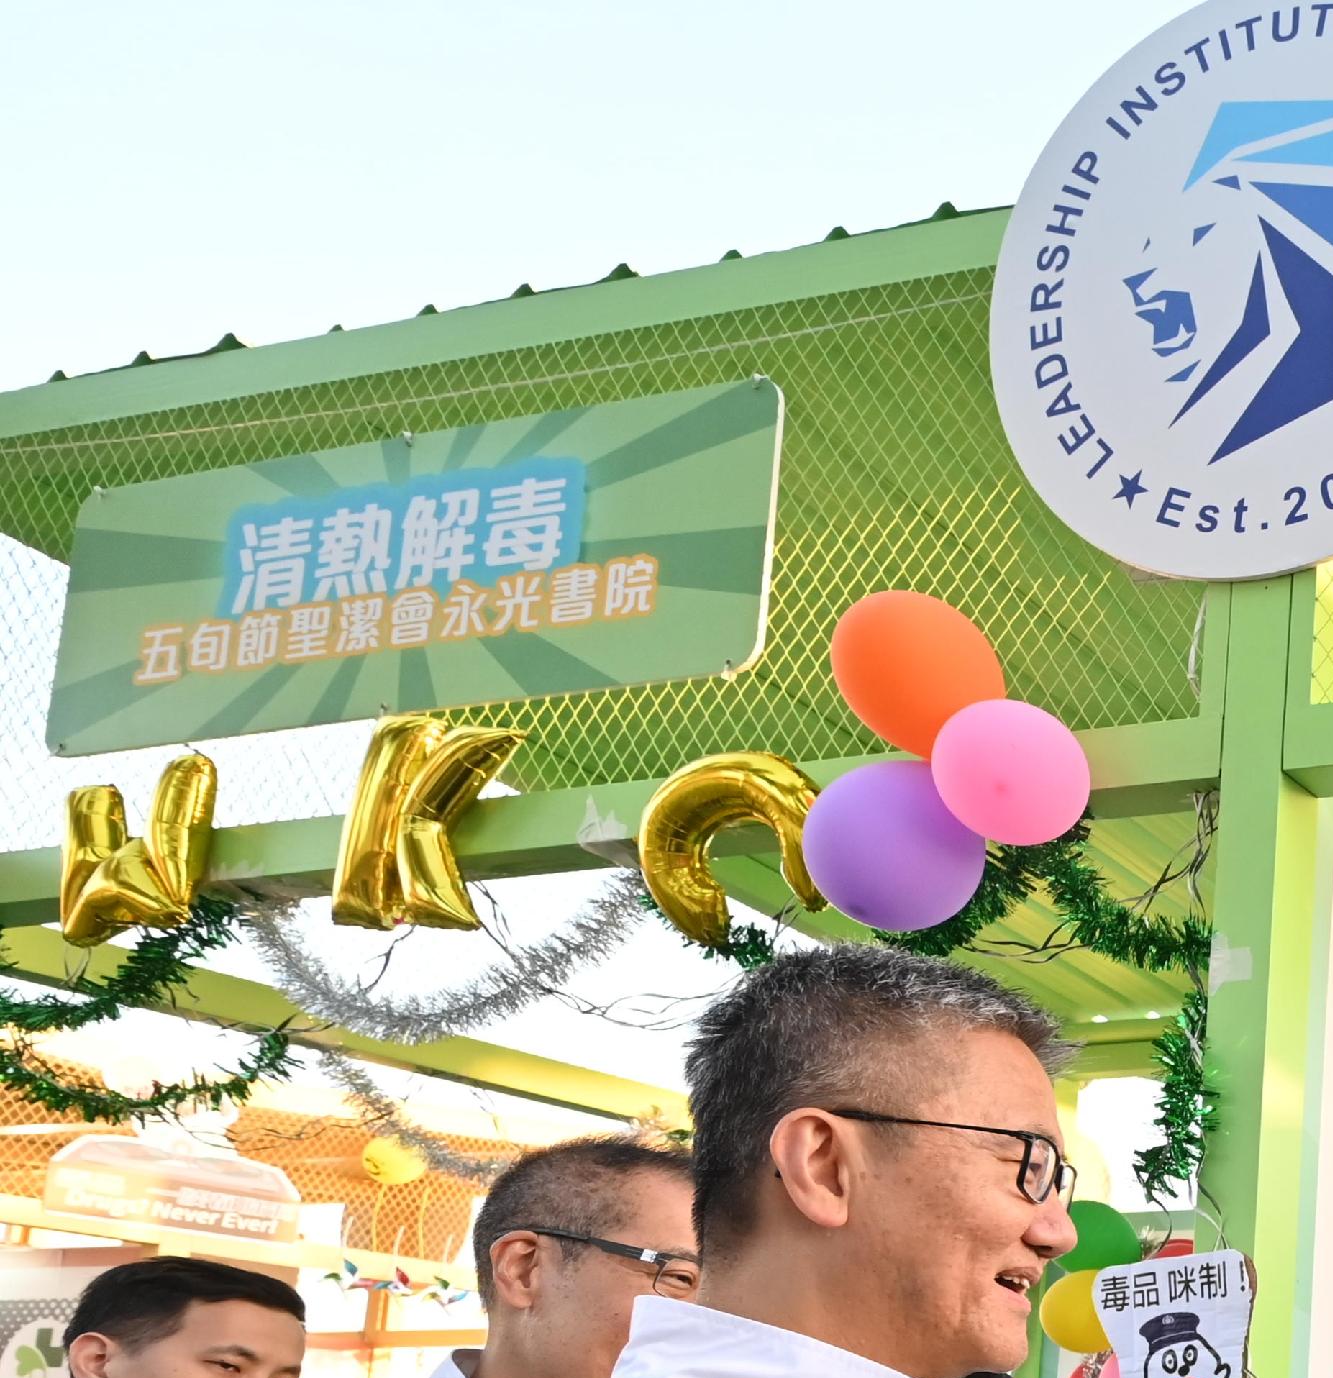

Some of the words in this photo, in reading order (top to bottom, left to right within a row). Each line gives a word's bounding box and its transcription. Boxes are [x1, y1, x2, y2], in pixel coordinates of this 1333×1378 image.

[1030, 150, 1113, 479] LEADERSHIP
[231, 477, 566, 614] 清熱解毒
[138, 559, 656, 681] 五旬節聖潔會永光書院
[152, 1203, 220, 1229] Never
